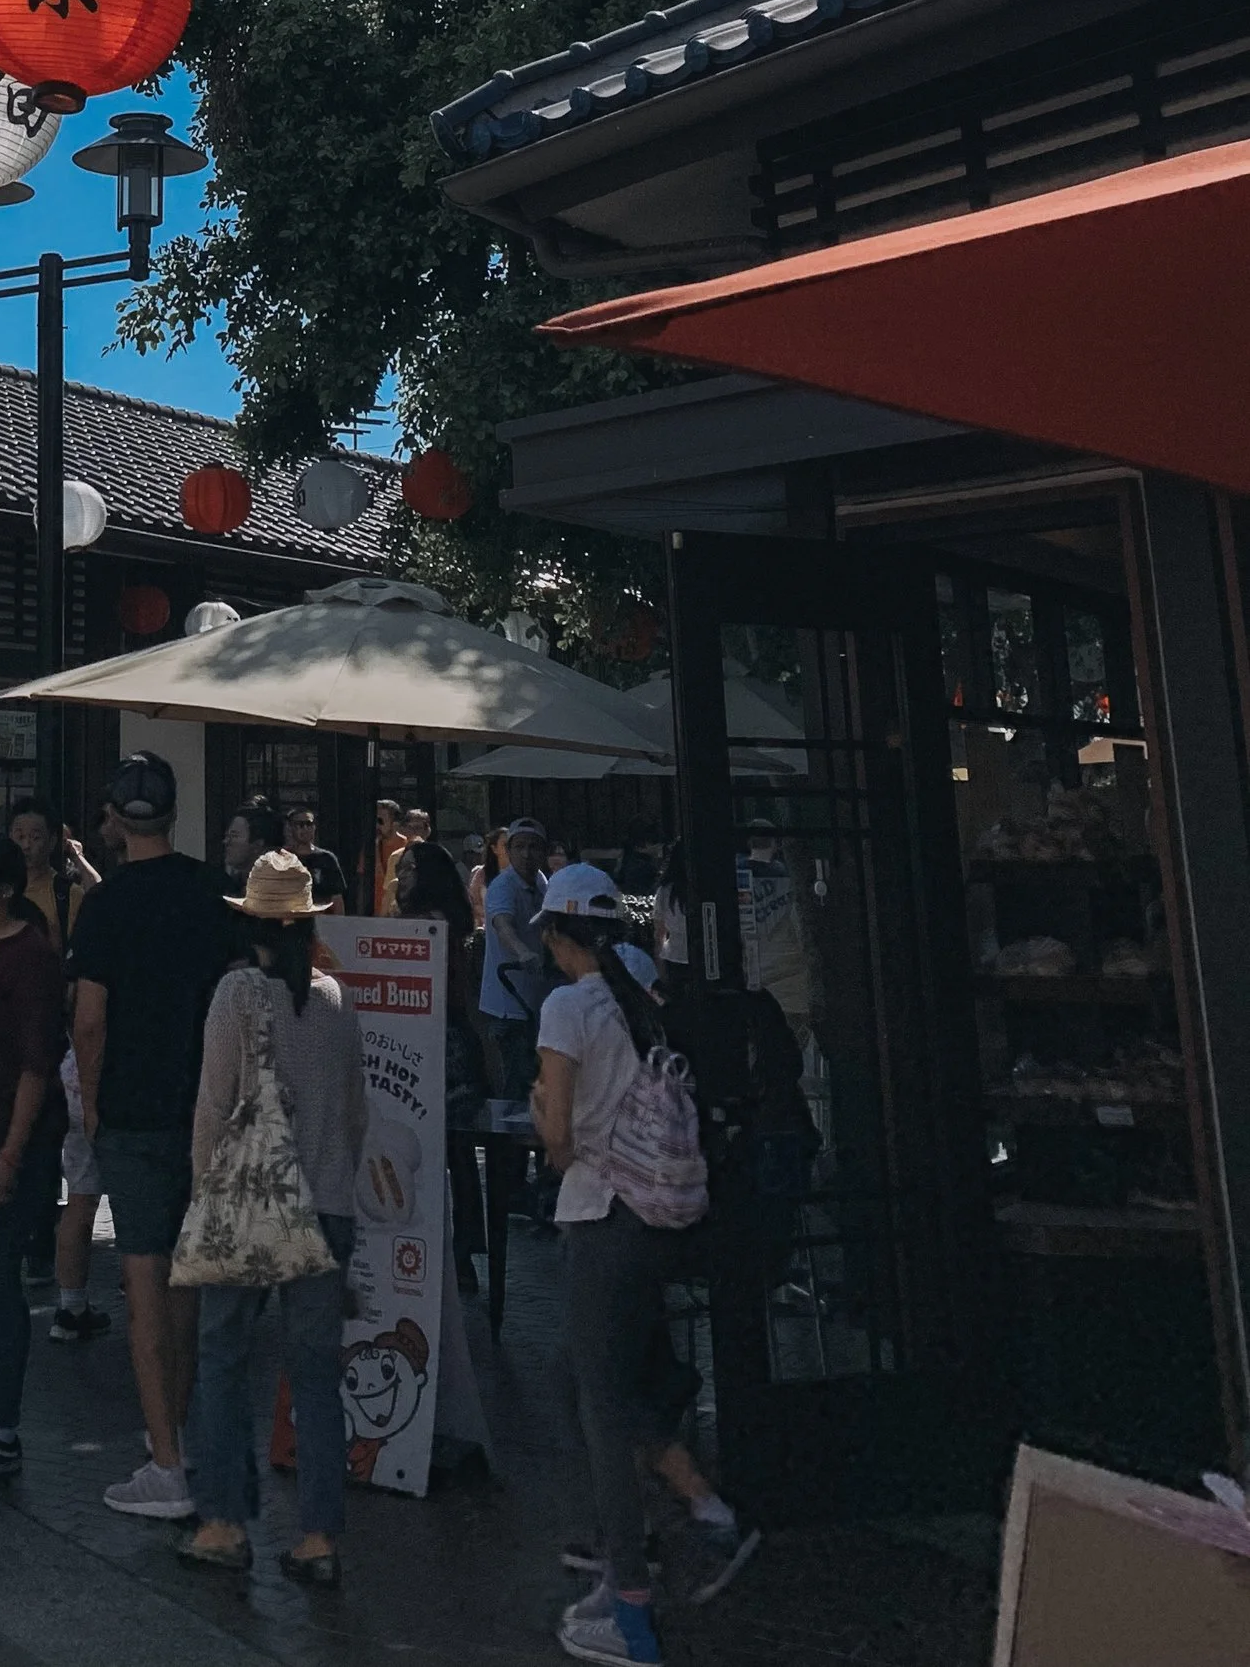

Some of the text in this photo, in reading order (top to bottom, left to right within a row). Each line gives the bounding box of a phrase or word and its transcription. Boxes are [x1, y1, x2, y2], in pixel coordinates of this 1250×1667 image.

[375, 941, 427, 956] ヤマサキ
[386, 981, 429, 1008] Buns
[385, 1059, 419, 1088] HOT
[369, 1073, 427, 1121] TASTY!
